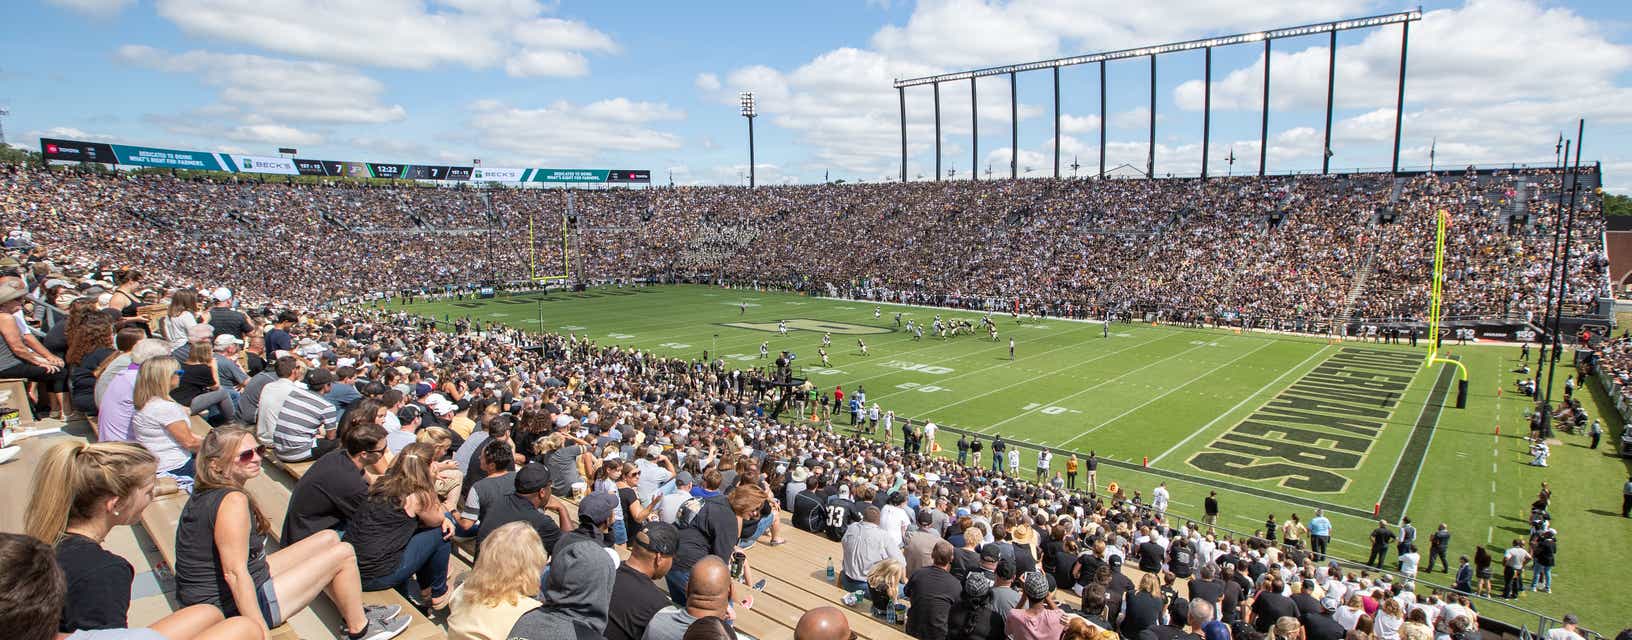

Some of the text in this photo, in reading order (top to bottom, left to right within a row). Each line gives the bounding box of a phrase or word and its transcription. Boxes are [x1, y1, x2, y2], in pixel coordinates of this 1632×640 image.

[335, 164, 343, 173] 7
[377, 165, 398, 174] 12:22
[431, 168, 439, 177] 7
[1021, 402, 1068, 415] 10
[825, 505, 845, 528] 33
